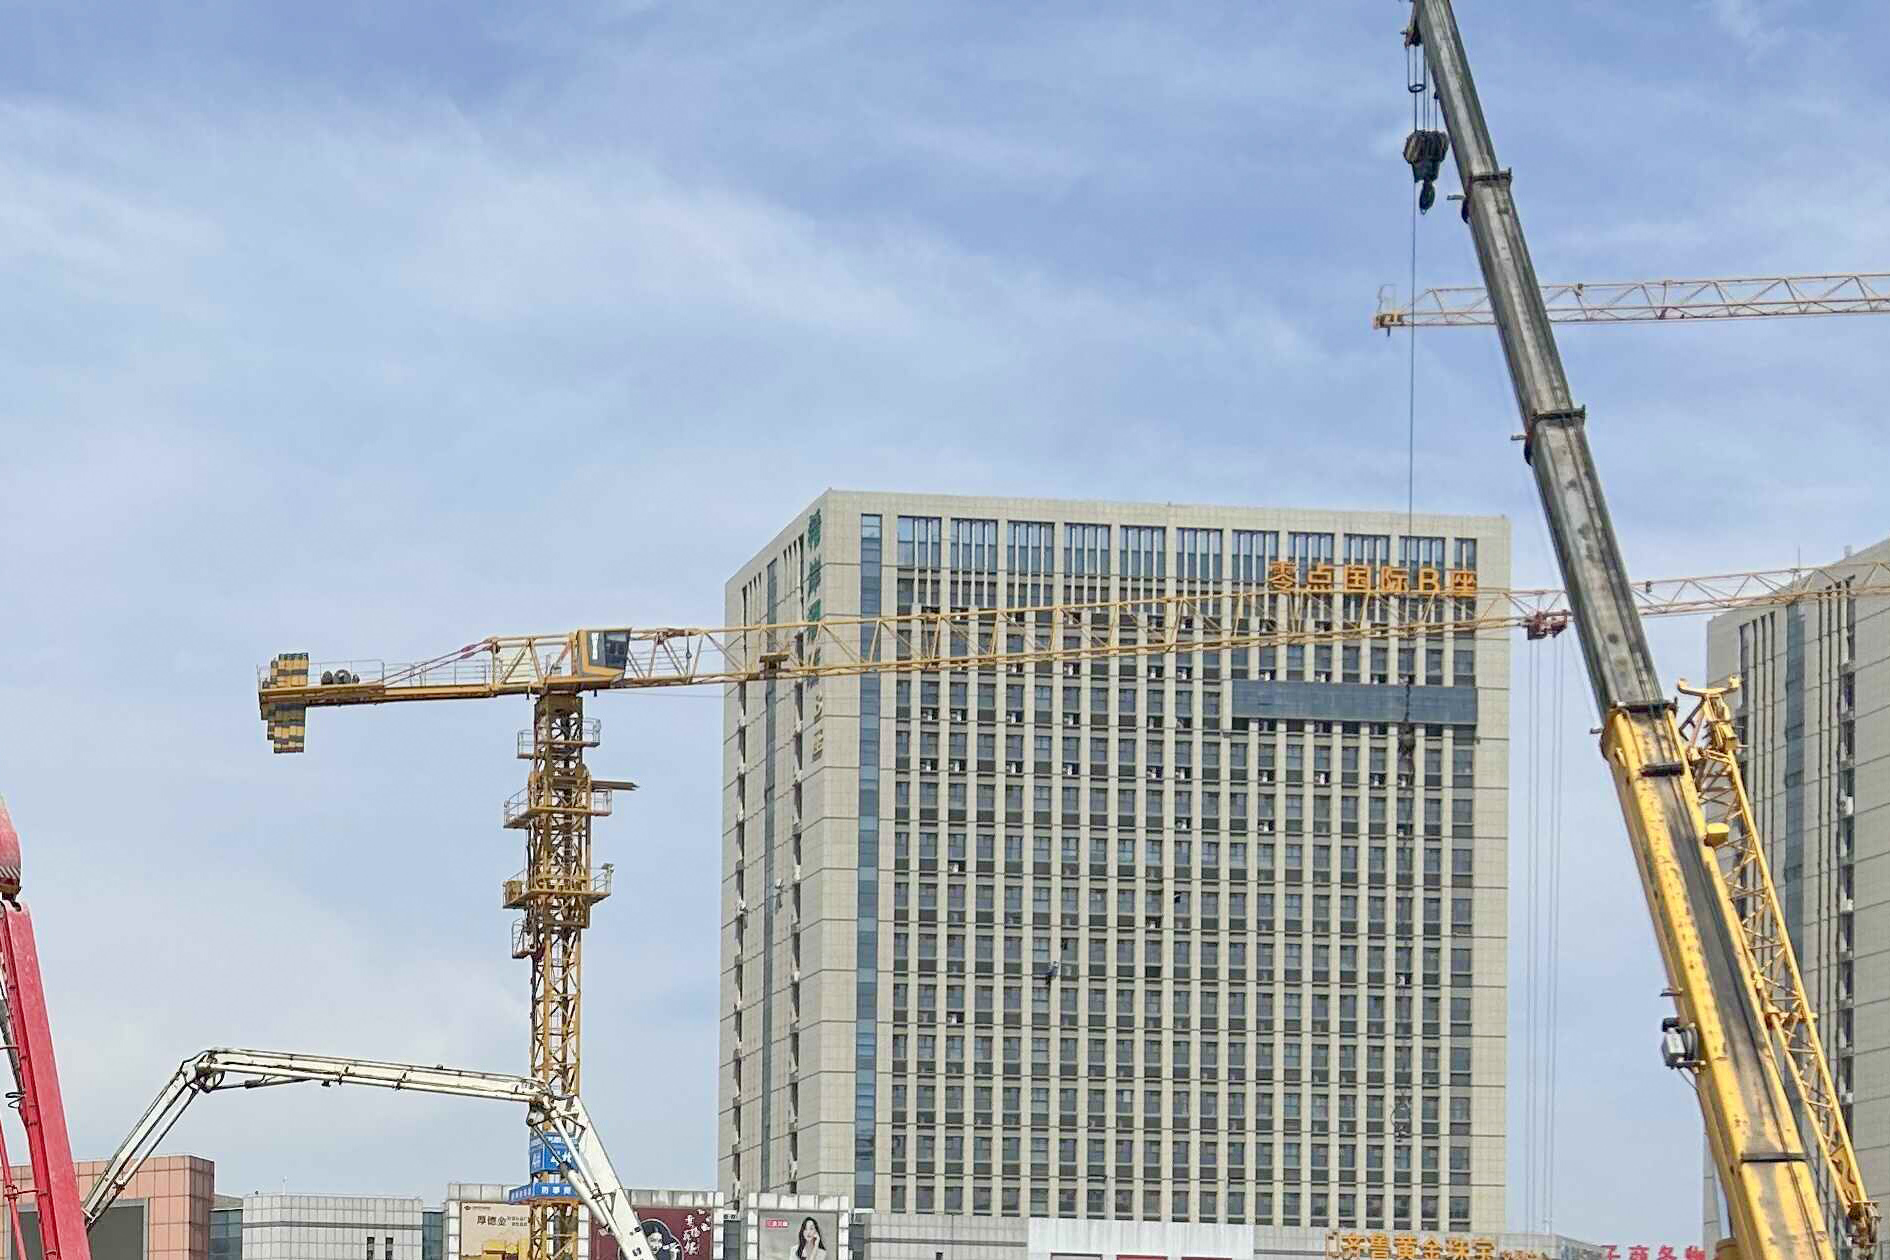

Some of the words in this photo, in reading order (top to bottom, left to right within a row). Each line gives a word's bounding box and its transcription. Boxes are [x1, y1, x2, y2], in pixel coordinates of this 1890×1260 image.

[1268, 560, 1478, 598] 零点国际B座
